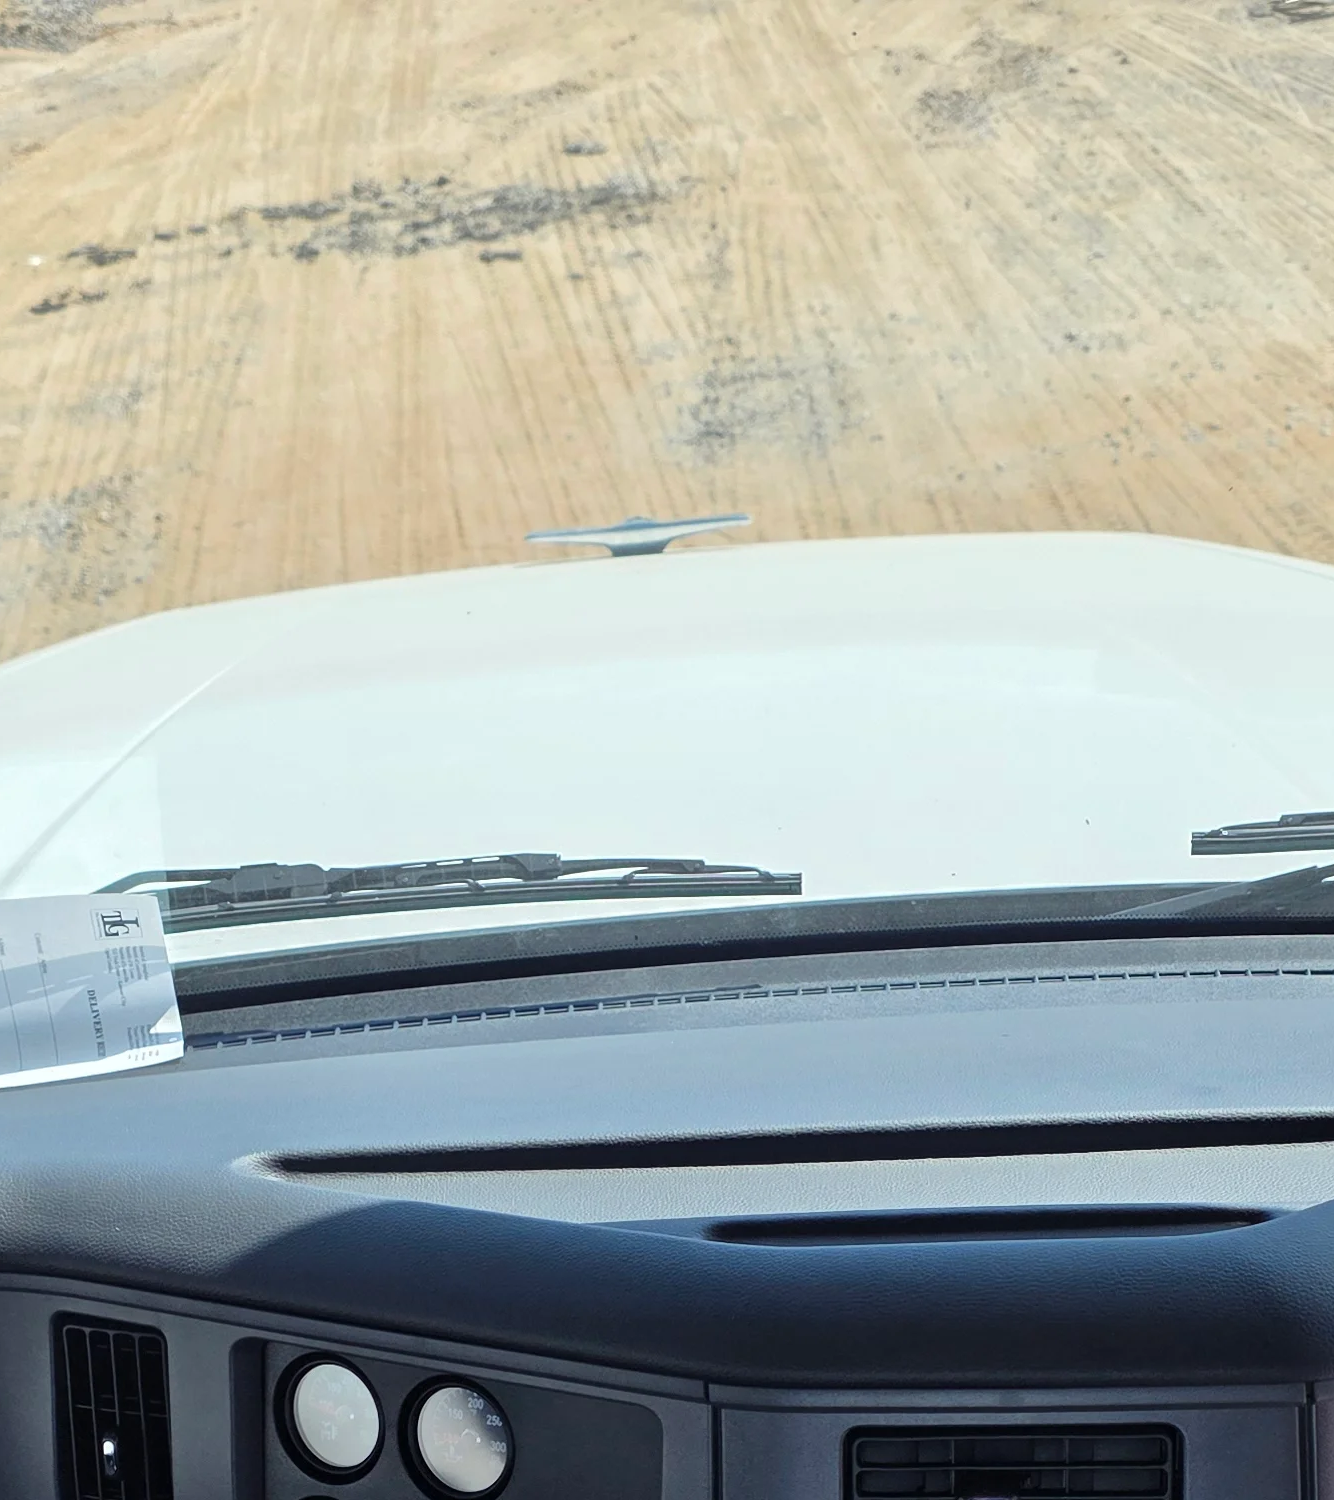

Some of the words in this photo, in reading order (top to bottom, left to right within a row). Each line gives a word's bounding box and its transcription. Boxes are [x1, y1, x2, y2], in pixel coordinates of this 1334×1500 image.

[87, 988, 105, 1040] DELIVERY
[467, 1397, 484, 1410] 200
[448, 1408, 463, 1420] 150
[491, 1440, 507, 1453] 300
